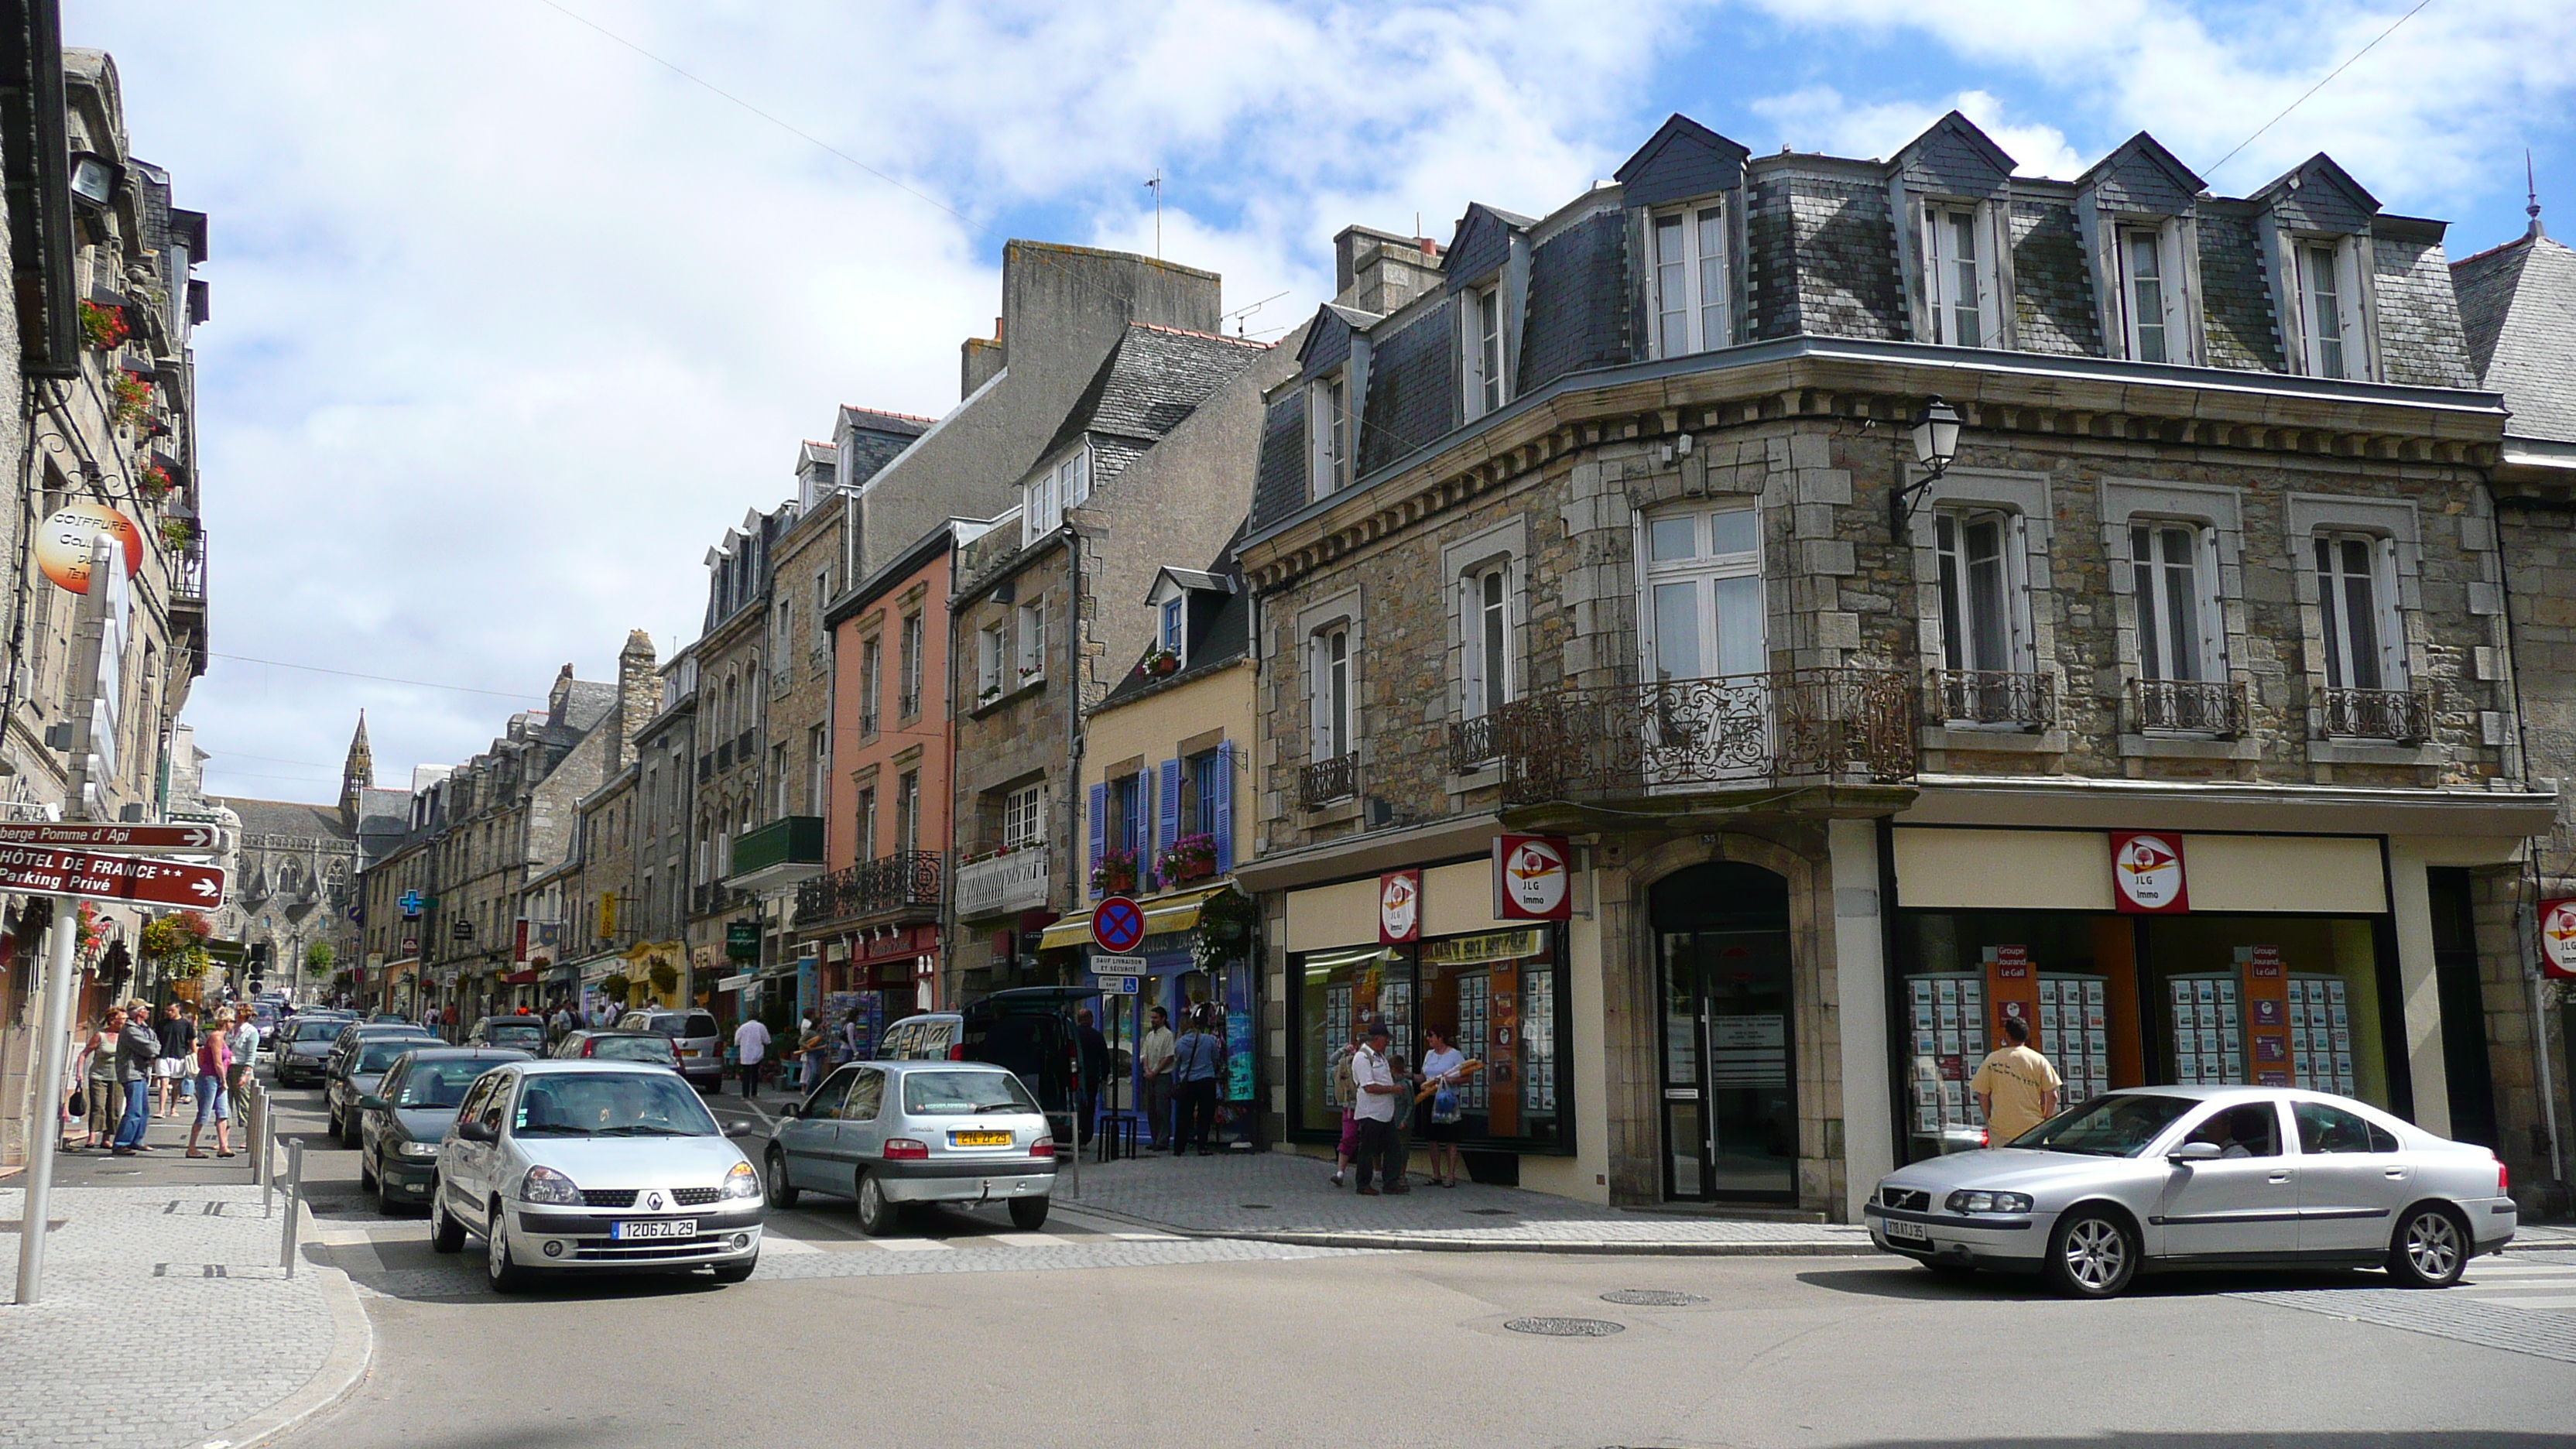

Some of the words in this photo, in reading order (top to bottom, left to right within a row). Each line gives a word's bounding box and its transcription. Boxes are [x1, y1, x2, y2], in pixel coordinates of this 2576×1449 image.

[54, 514, 129, 532] COIFFURE
[60, 534, 91, 548] COUL
[67, 567, 91, 581] TEM
[0, 828, 36, 841] berge
[40, 827, 88, 841] Pomme
[0, 849, 54, 868] HÔTEL
[61, 857, 85, 871] DE
[92, 860, 157, 879] FRANCE
[0, 868, 61, 889] Parking
[69, 875, 110, 891] Privé
[2136, 875, 2153, 885] JLG
[1523, 881, 1539, 890] JLG
[2137, 889, 2159, 899] Immo
[1523, 895, 1544, 904] Immo
[1999, 947, 2025, 956] Groupe
[2253, 947, 2276, 956] Groupe
[2562, 955, 2576, 964] Imm
[995, 1132, 1006, 1142] 29
[625, 1223, 658, 1237] 1206
[660, 1222, 675, 1236] ZL
[678, 1222, 694, 1235] 29
